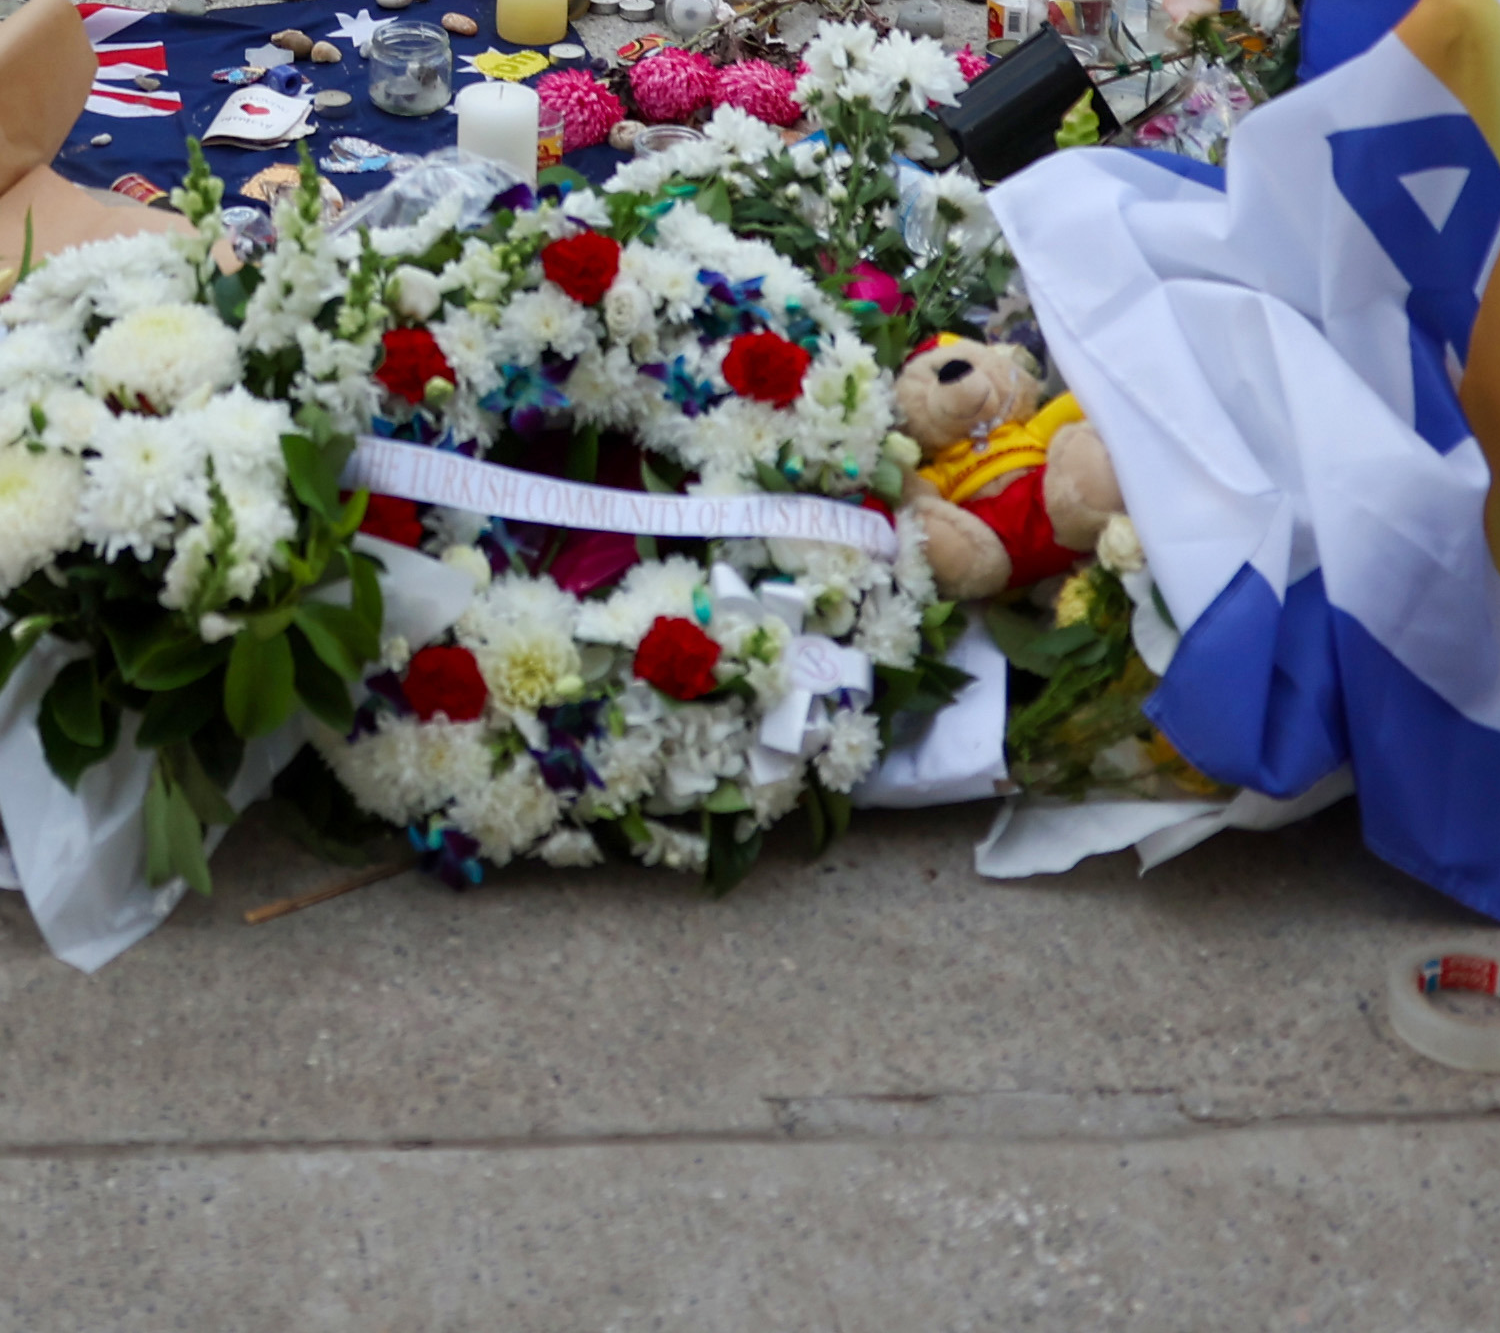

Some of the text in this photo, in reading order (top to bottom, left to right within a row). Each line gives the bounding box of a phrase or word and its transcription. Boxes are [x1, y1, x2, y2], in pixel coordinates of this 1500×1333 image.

[411, 450, 520, 514] TURKISH
[525, 484, 690, 532] COMMUNITY
[697, 501, 730, 534] OF
